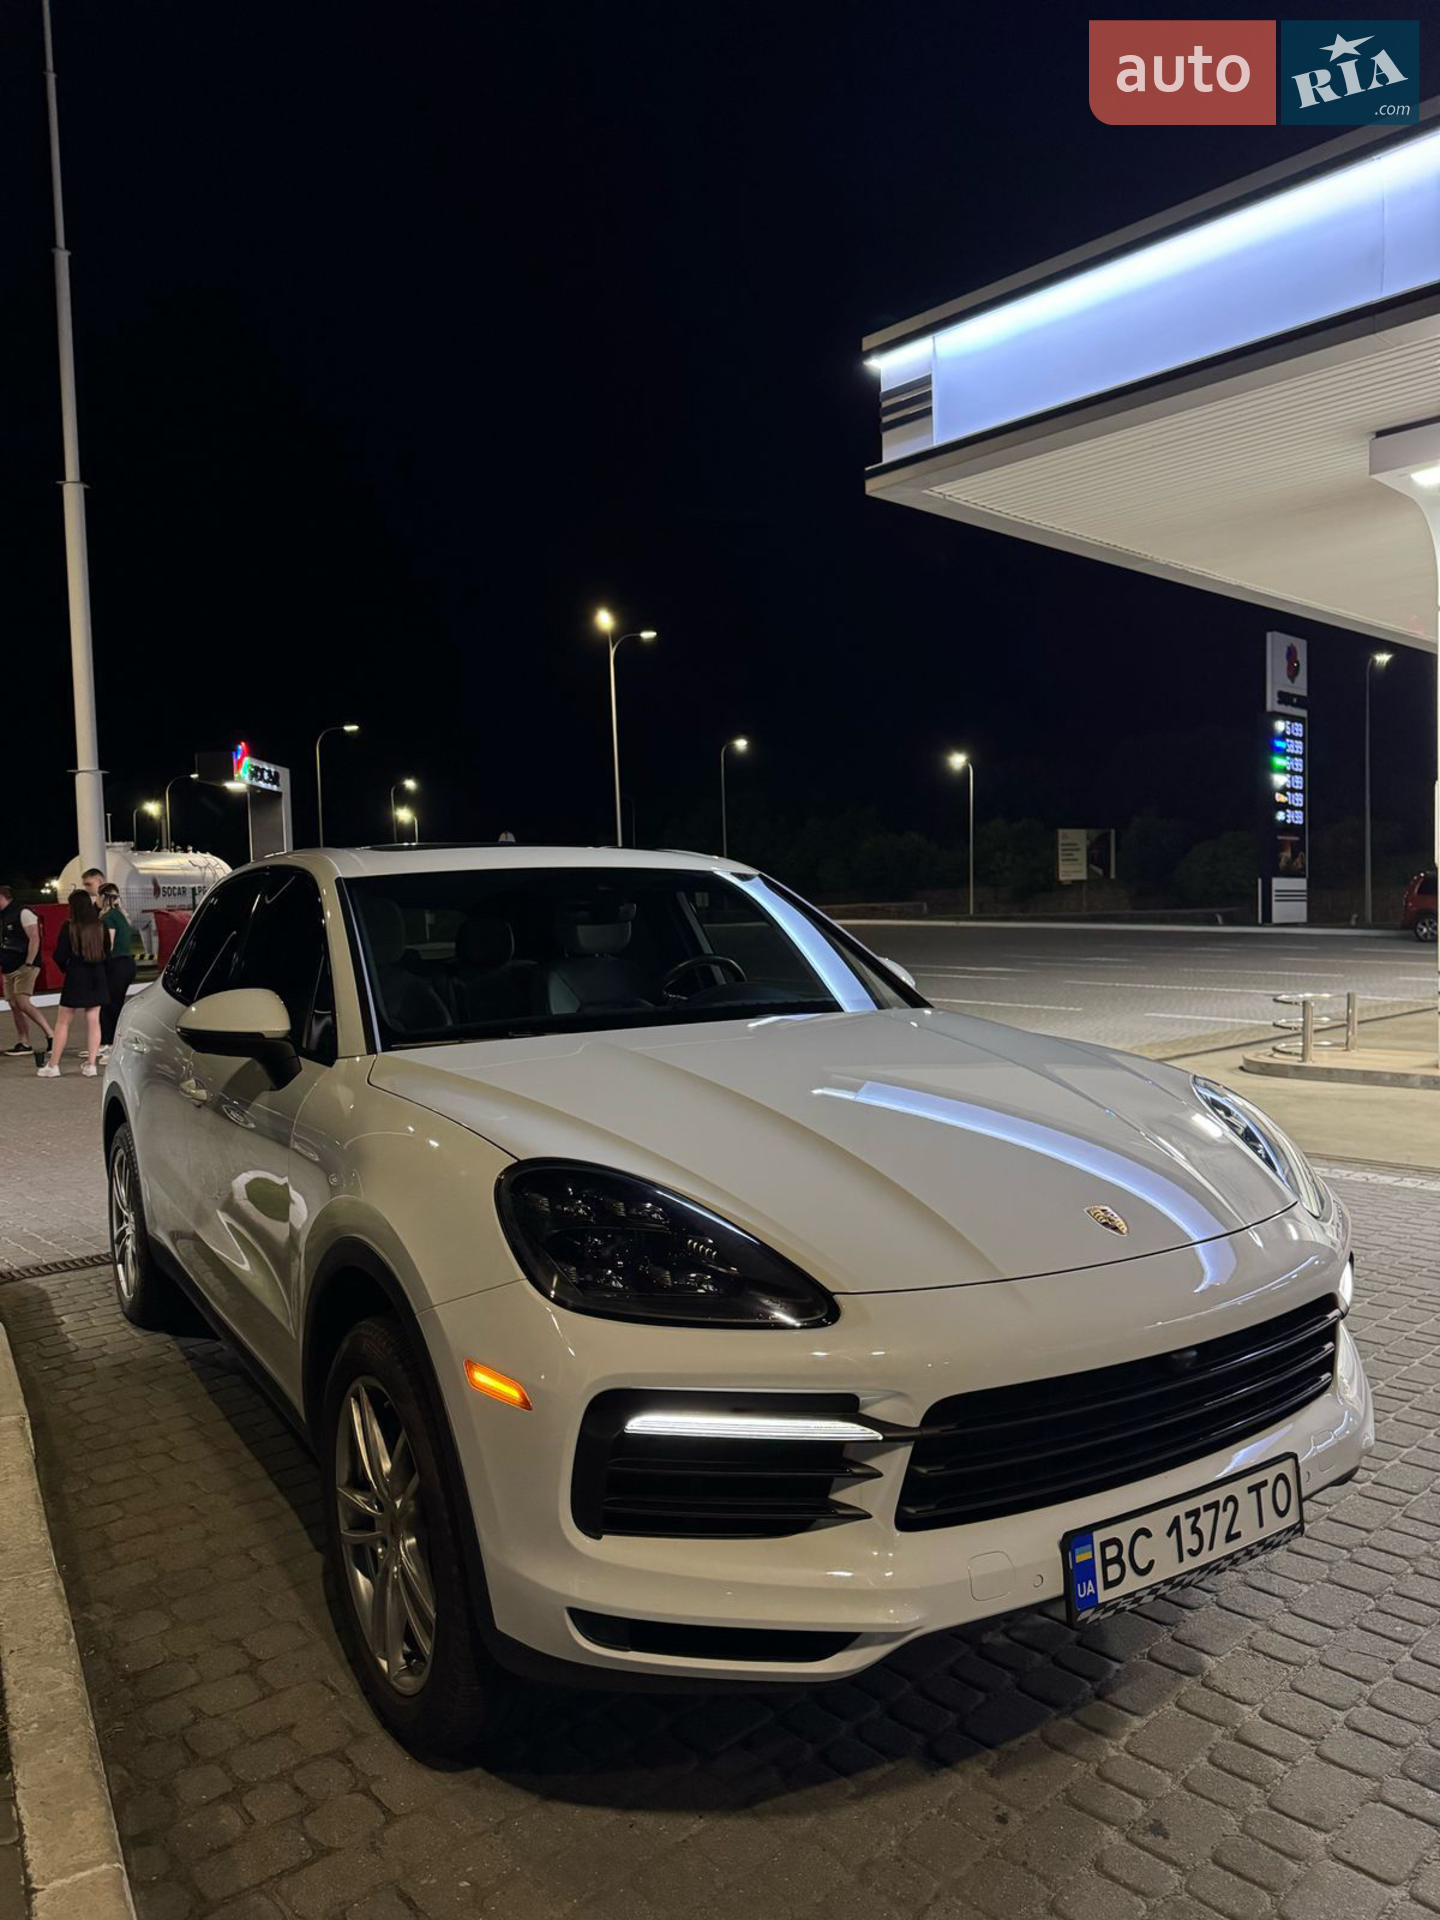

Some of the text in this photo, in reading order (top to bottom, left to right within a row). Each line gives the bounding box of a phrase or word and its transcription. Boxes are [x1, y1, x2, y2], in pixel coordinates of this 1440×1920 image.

[161, 885, 188, 898] SOCAR
[1100, 1472, 1292, 1591] BC 1372 TO
[1077, 1579, 1096, 1599] UA
